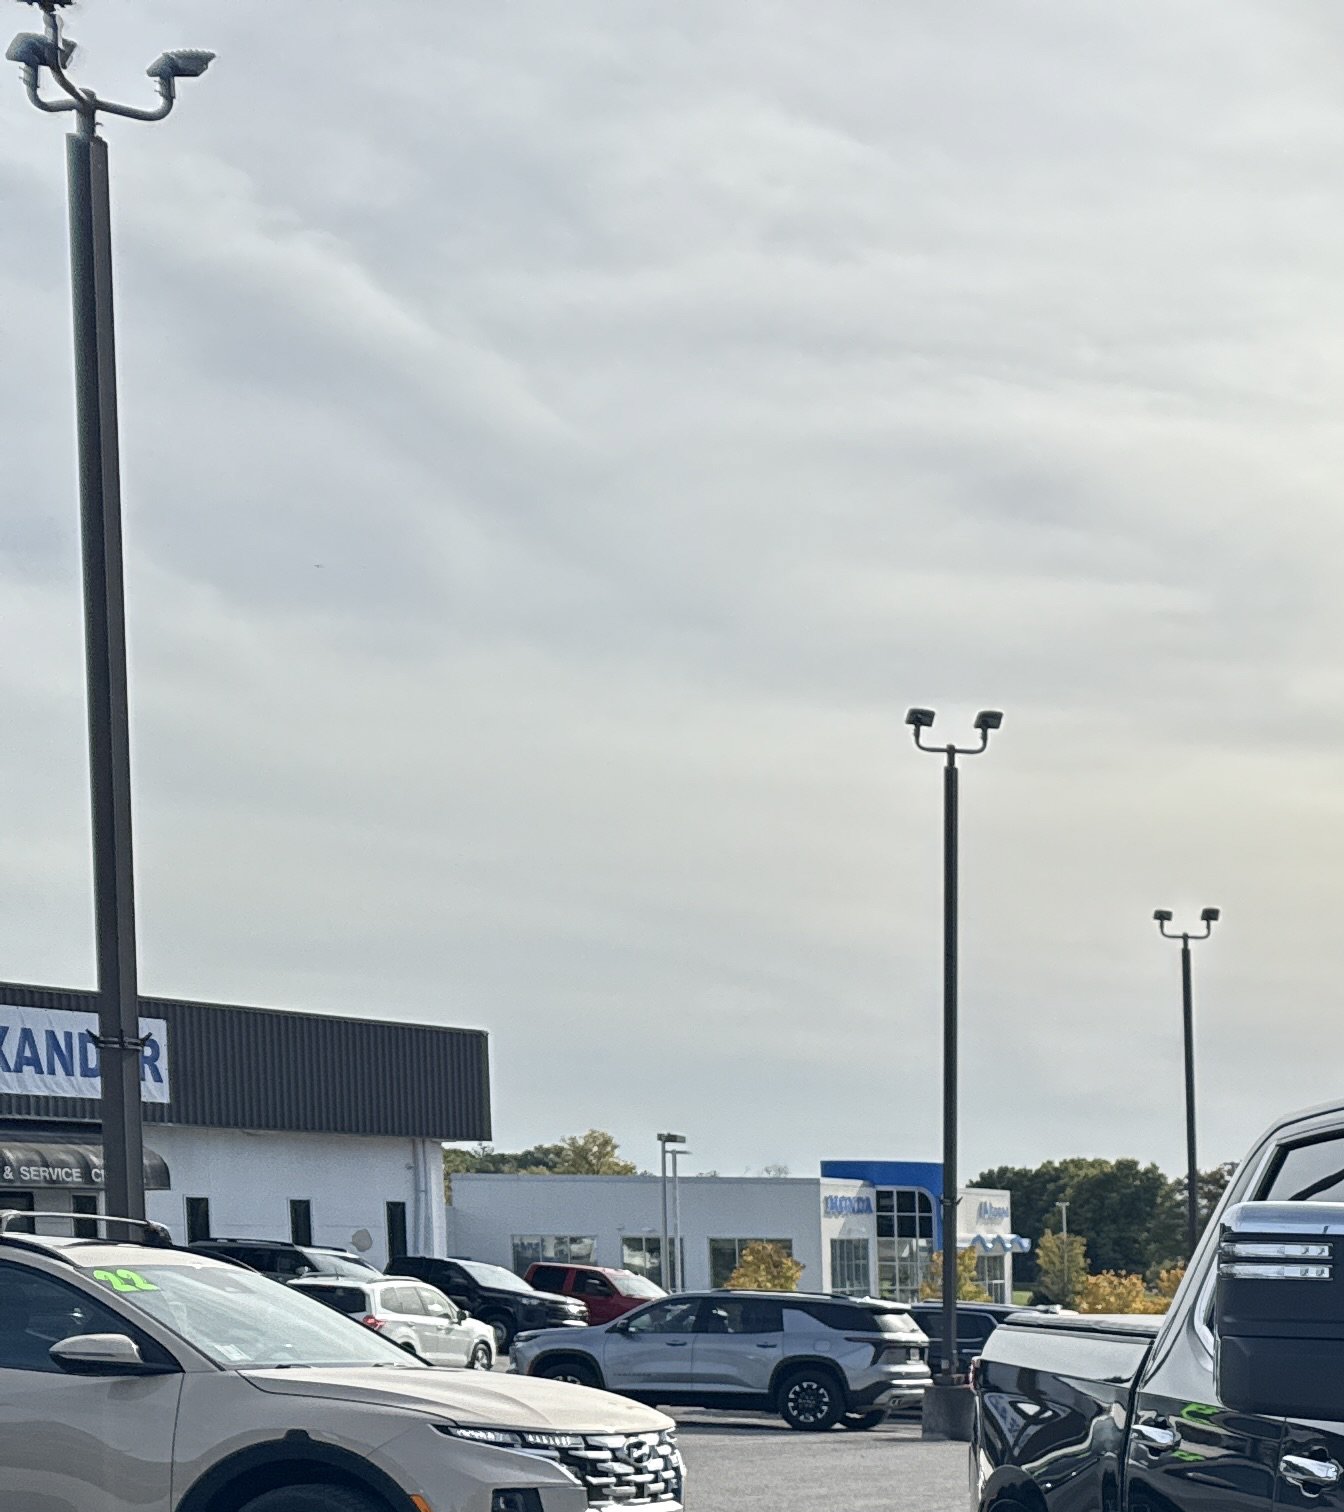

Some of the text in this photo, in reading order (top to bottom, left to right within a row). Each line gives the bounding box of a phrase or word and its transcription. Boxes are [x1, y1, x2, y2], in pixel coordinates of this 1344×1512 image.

[0, 1026, 163, 1083] ANDR
[3, 1166, 14, 1180] &
[20, 1166, 82, 1182] SERVICE
[93, 1269, 160, 1292] 22
